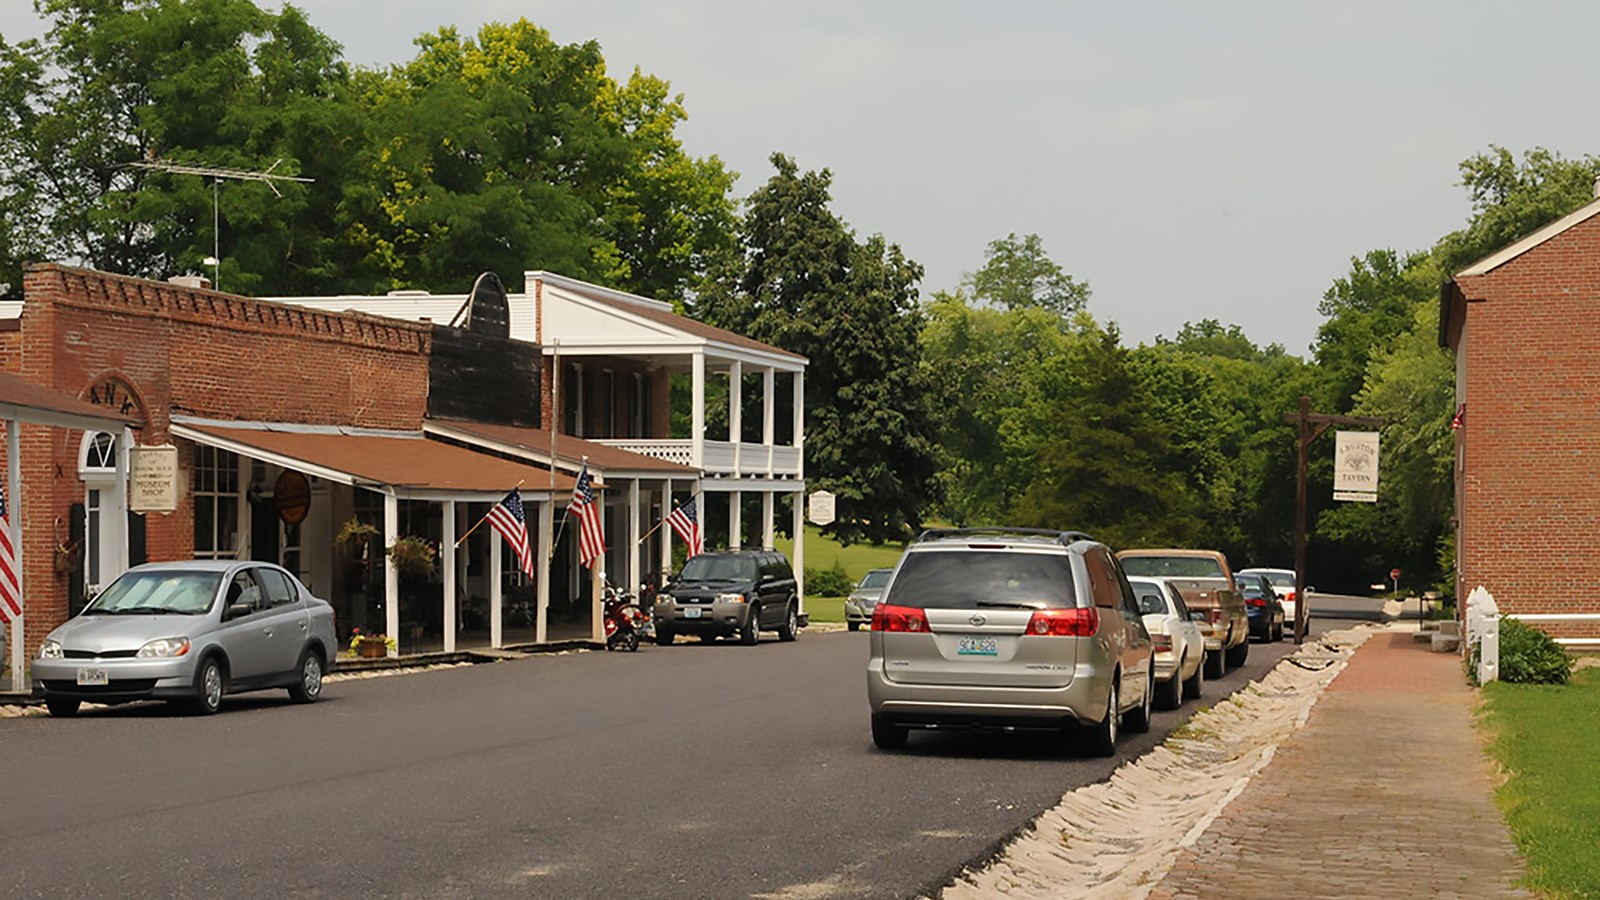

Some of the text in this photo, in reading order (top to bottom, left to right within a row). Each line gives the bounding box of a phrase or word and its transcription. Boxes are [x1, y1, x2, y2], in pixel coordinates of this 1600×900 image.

[90, 382, 135, 417] ANK
[1342, 473, 1371, 482] TAVERN
[136, 480, 171, 488] MUSEUM
[142, 489, 164, 497] SHOP
